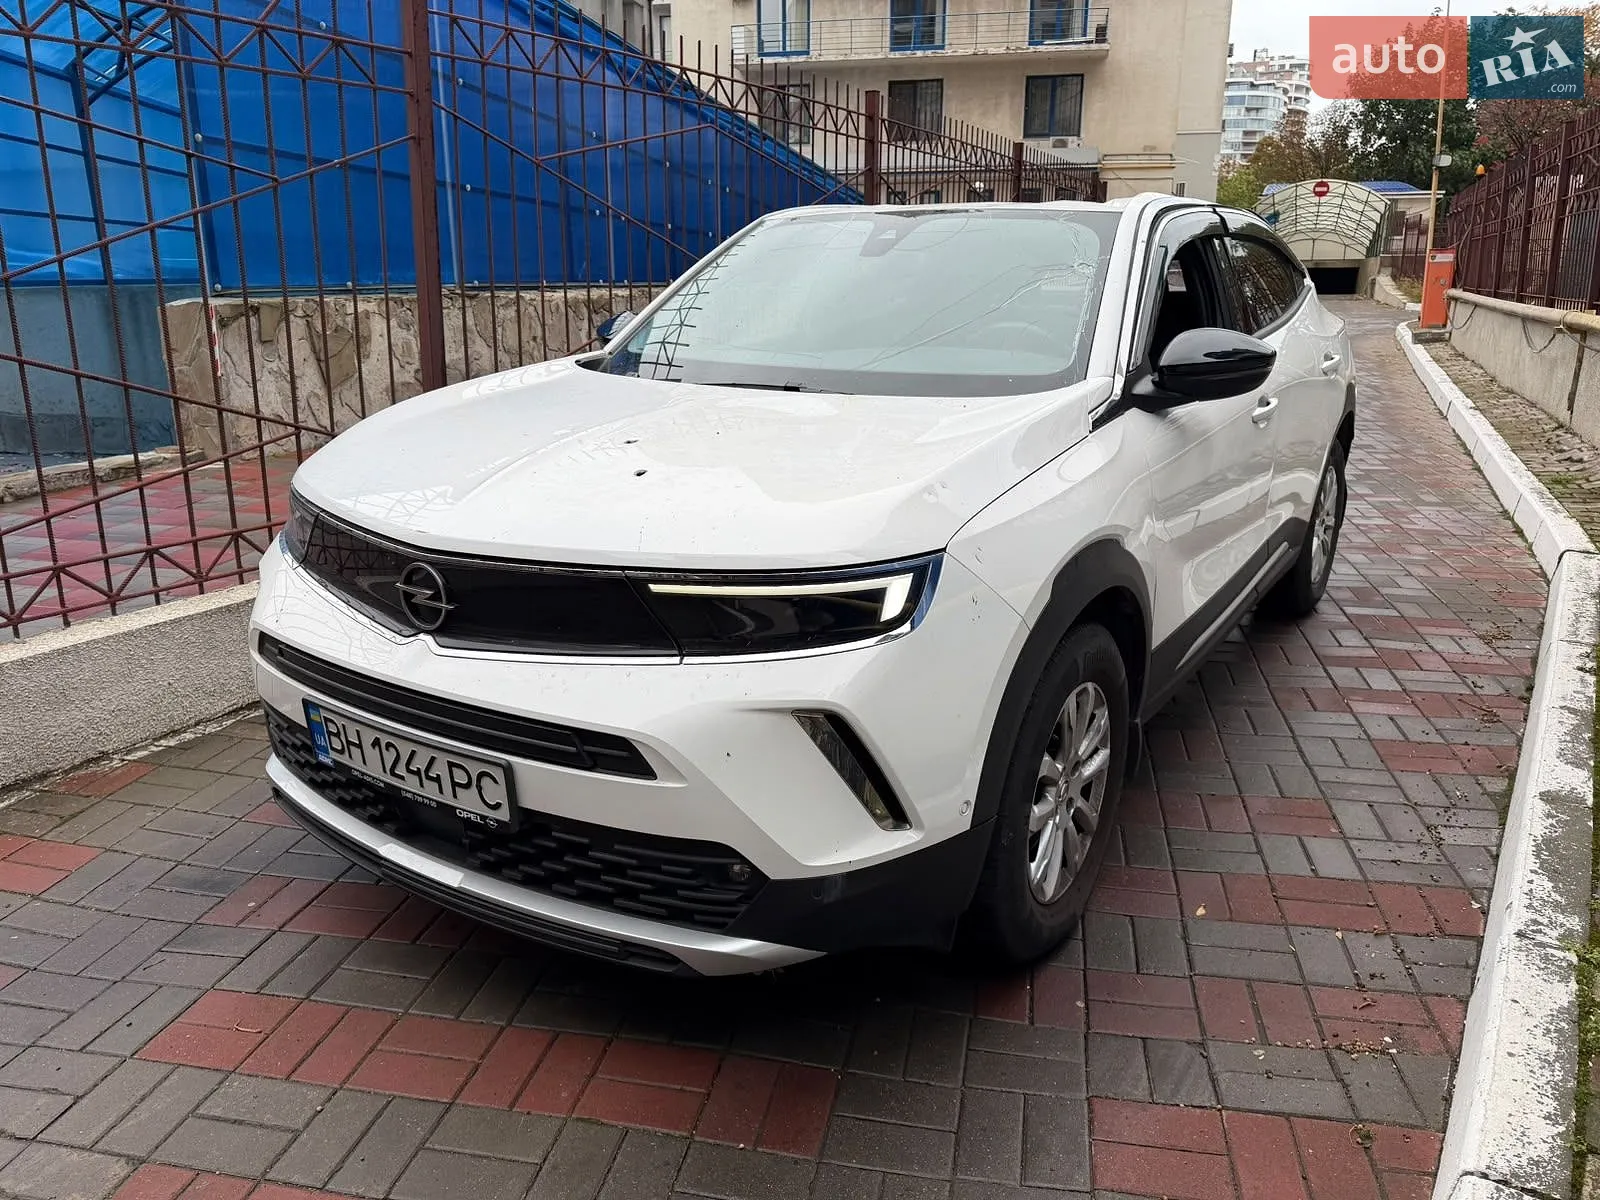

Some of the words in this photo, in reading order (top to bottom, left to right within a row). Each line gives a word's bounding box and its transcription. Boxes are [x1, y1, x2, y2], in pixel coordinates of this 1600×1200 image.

[314, 732, 327, 747] UA
[322, 715, 367, 766] BH
[370, 736, 444, 795] 1244
[446, 760, 502, 810] PC
[456, 809, 485, 824] OPEL
